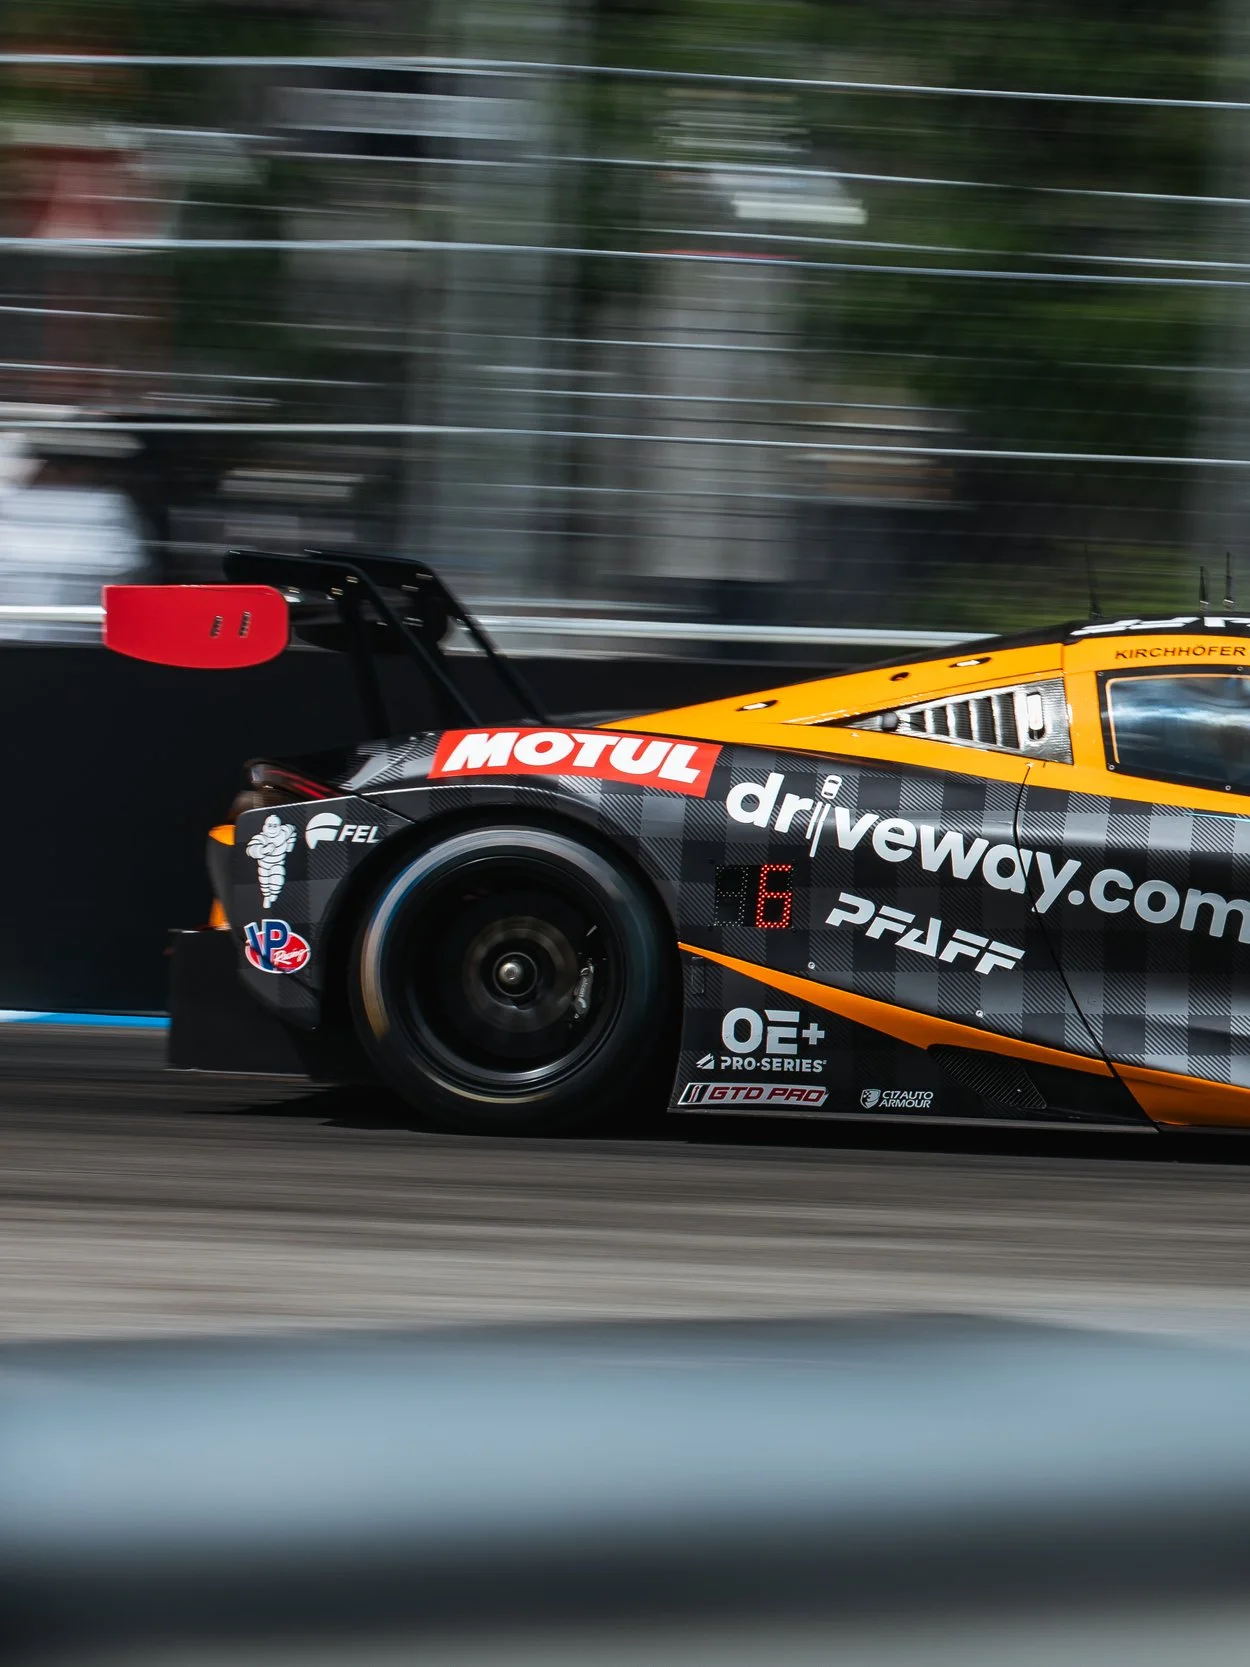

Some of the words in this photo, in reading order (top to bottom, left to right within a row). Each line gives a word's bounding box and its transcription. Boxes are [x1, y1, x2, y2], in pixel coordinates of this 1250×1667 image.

[1114, 644, 1246, 660] KIRCHHÖFER
[442, 732, 702, 784] MOTUL
[338, 824, 381, 844] FEL
[244, 919, 291, 971] VP
[825, 892, 1026, 976] PFAFF
[721, 1007, 826, 1055] OE+
[708, 1086, 764, 1100] GTD
[766, 1087, 825, 1102] PRO
[878, 1099, 931, 1108] ARMOUR
